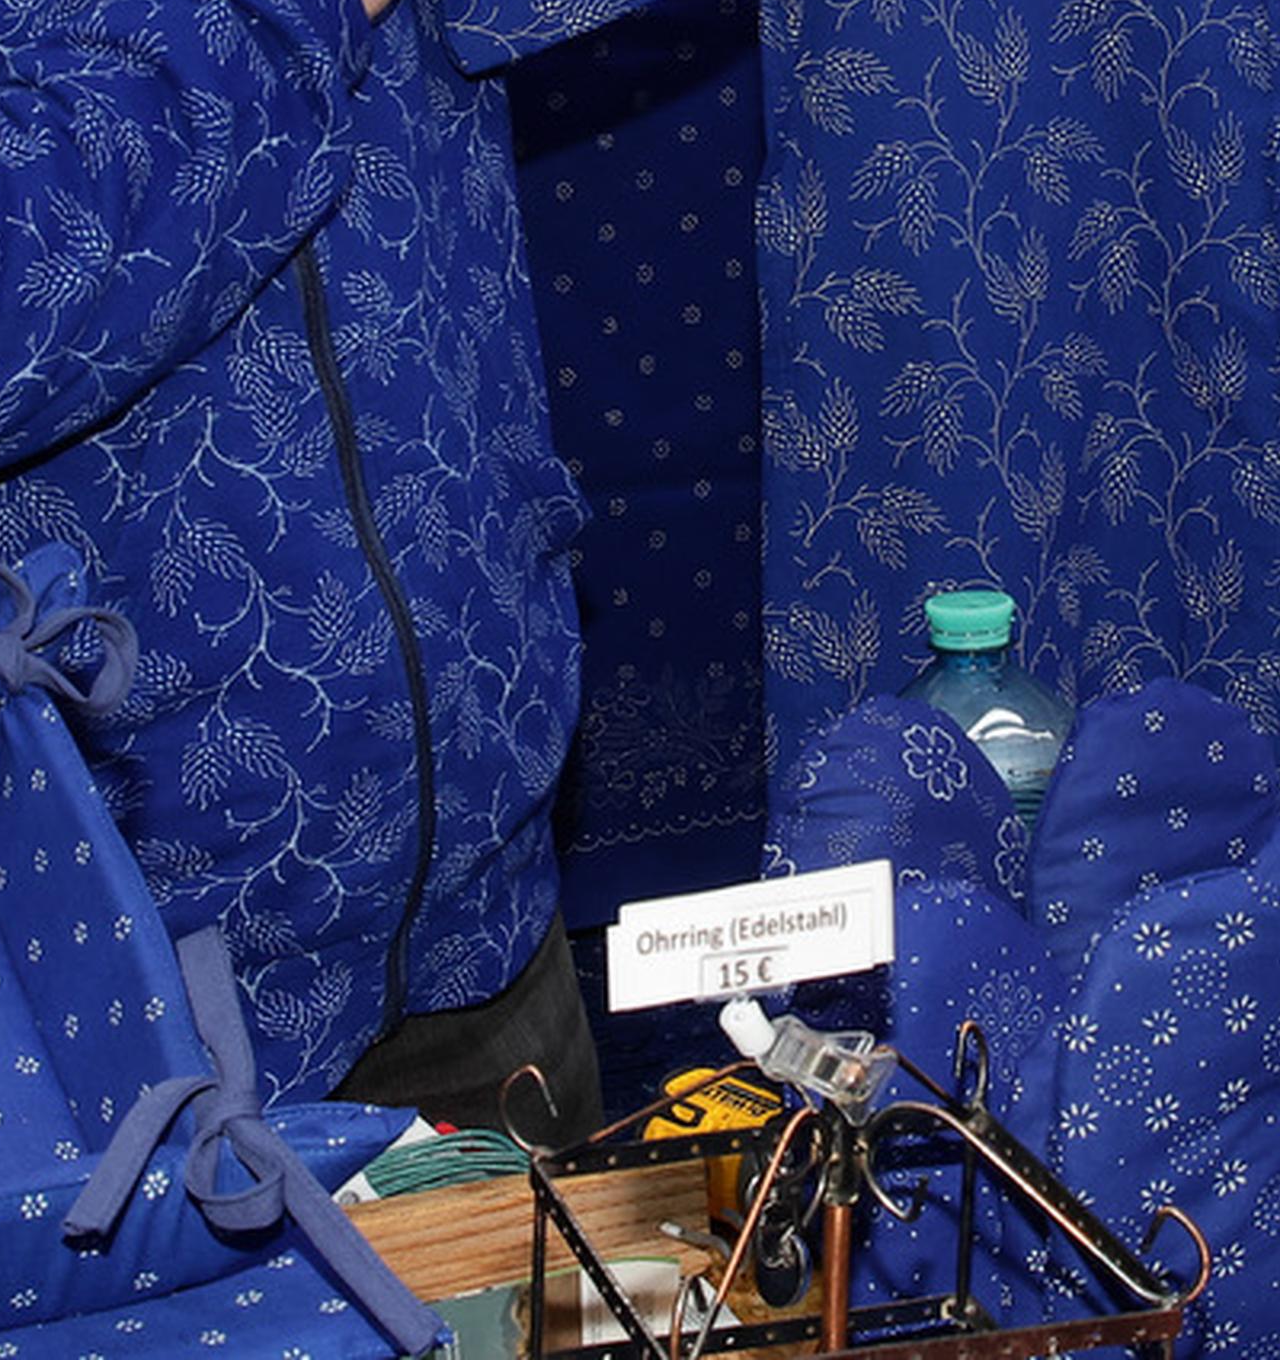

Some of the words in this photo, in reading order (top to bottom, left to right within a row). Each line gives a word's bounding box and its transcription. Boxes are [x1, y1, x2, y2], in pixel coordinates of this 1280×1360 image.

[636, 925, 723, 955] Ohrring
[729, 902, 848, 947] (Edelstahl)
[719, 959, 749, 989] 15
[757, 956, 775, 983] €
